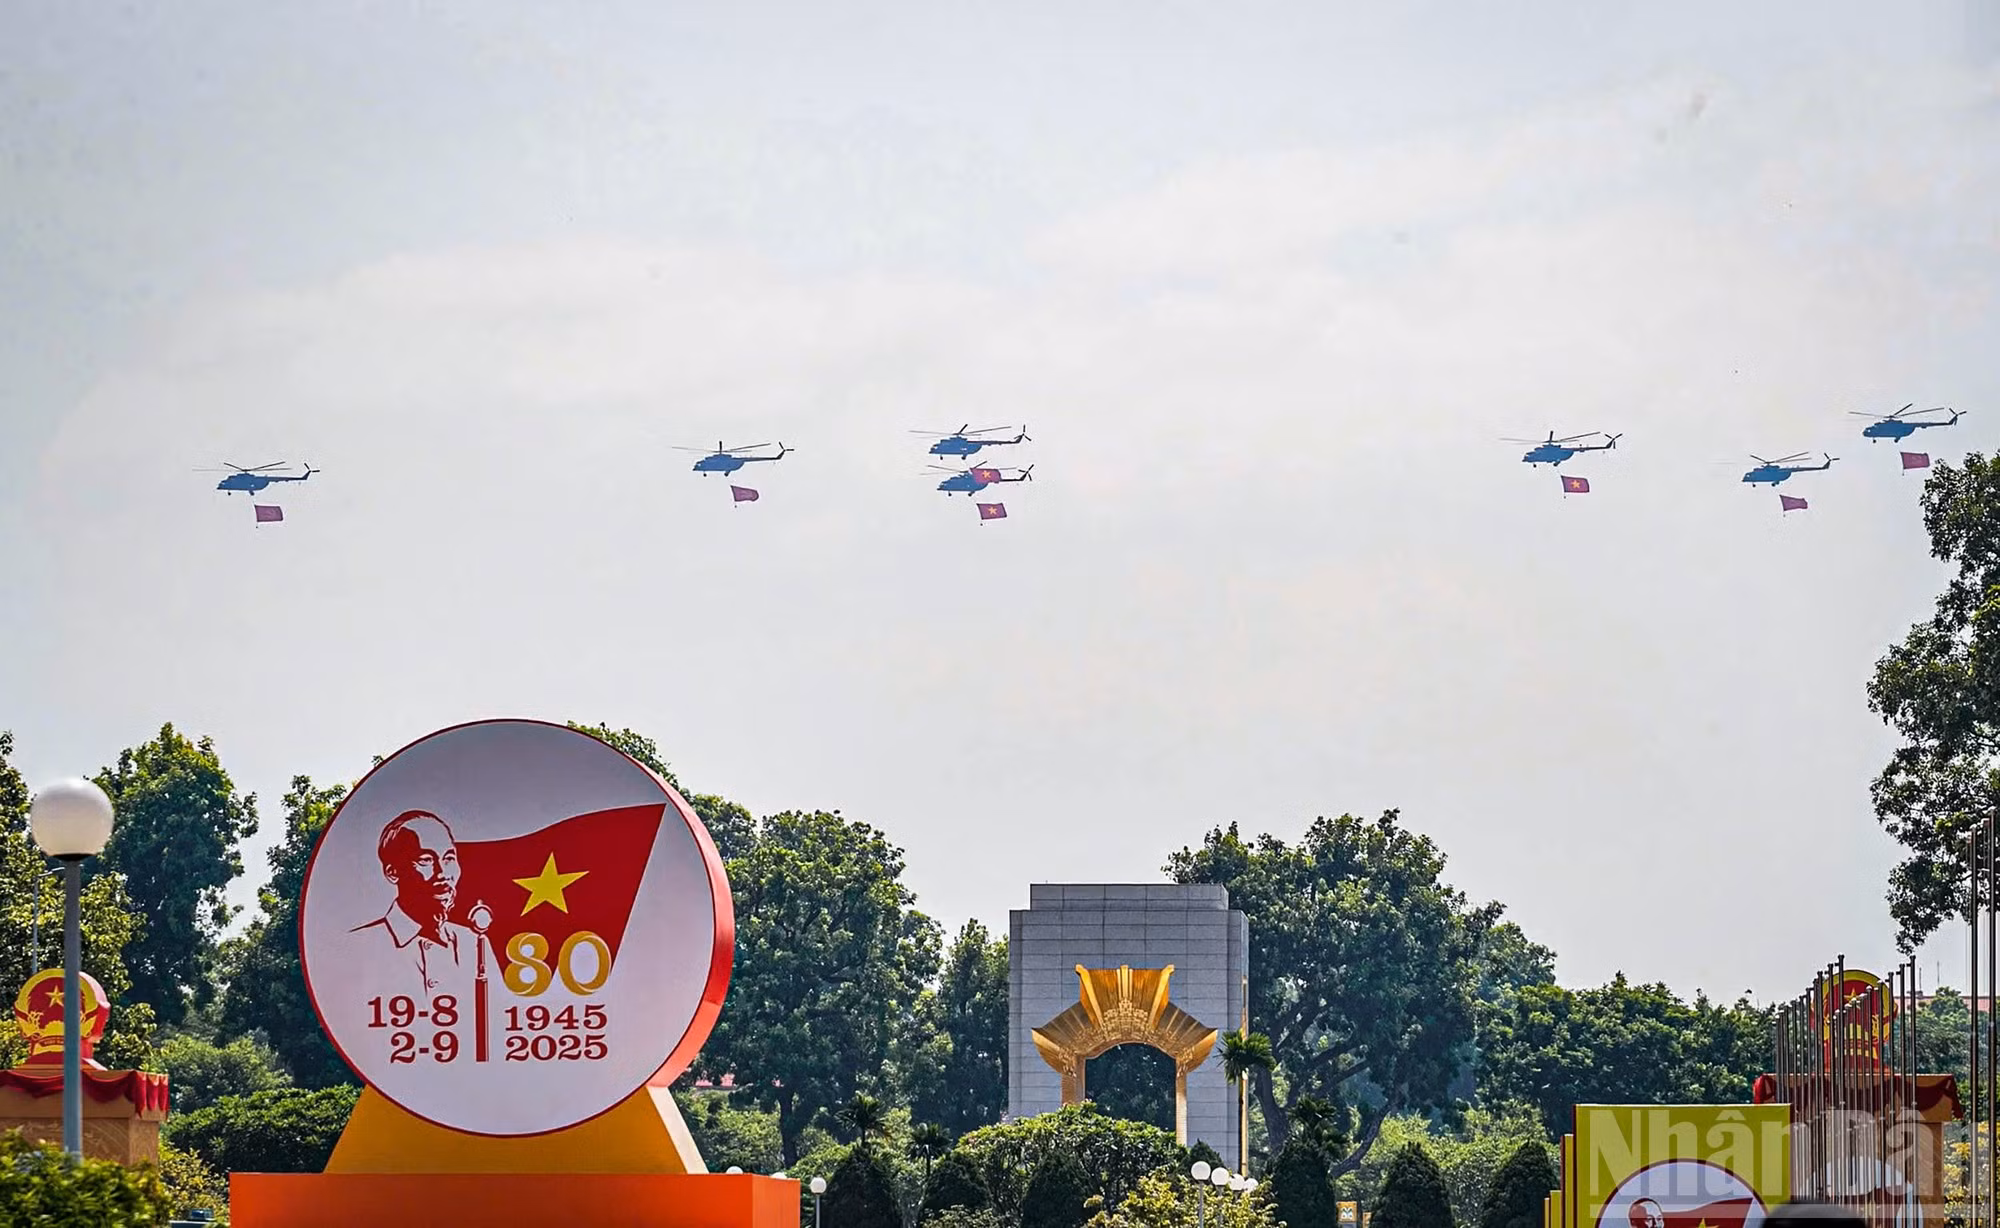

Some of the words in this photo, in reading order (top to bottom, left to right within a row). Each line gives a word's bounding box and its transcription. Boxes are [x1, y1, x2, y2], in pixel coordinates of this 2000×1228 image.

[504, 931, 612, 996] 80
[368, 995, 459, 1028] 19-8
[505, 1004, 608, 1031] 1945
[390, 1031, 459, 1064] 2-9
[505, 1034, 608, 1061] 2025
